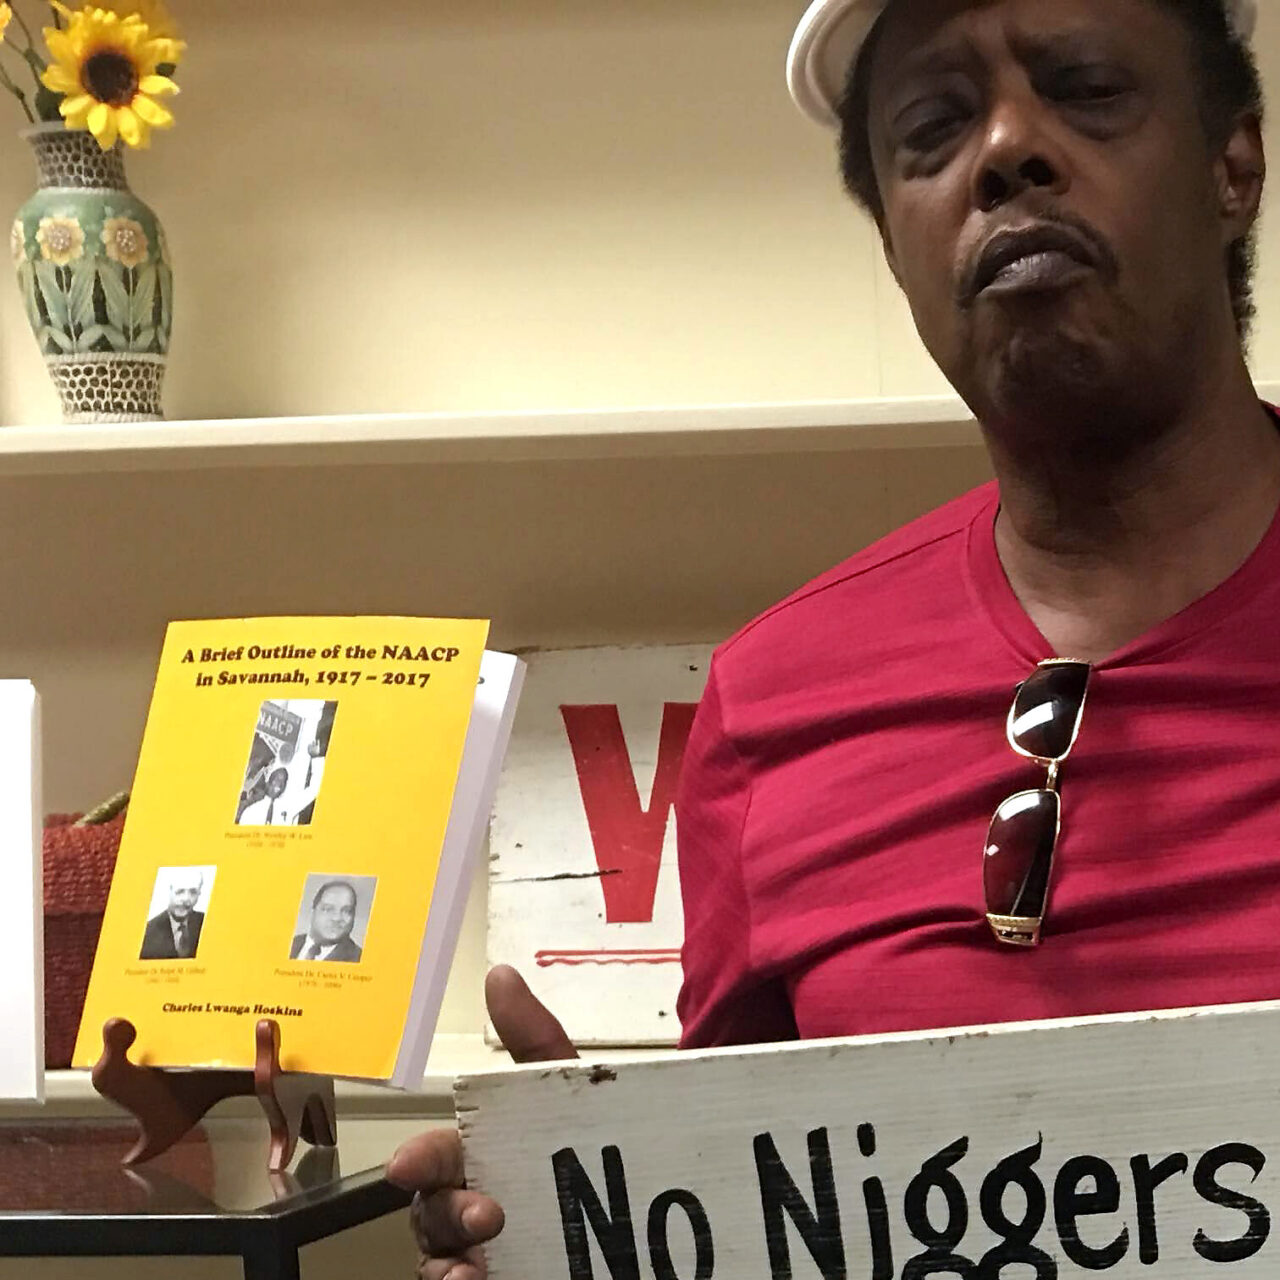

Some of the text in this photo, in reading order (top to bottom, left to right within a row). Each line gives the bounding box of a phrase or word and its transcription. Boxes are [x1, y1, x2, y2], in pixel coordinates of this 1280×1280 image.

[181, 644, 460, 663] A Brief Outline of the NAACP
[196, 672, 213, 686] in
[217, 669, 310, 687] Savannah,
[315, 671, 361, 687] 1917
[382, 672, 430, 688] 2017
[162, 1002, 303, 1016] Charles Lwanga Hoskins
